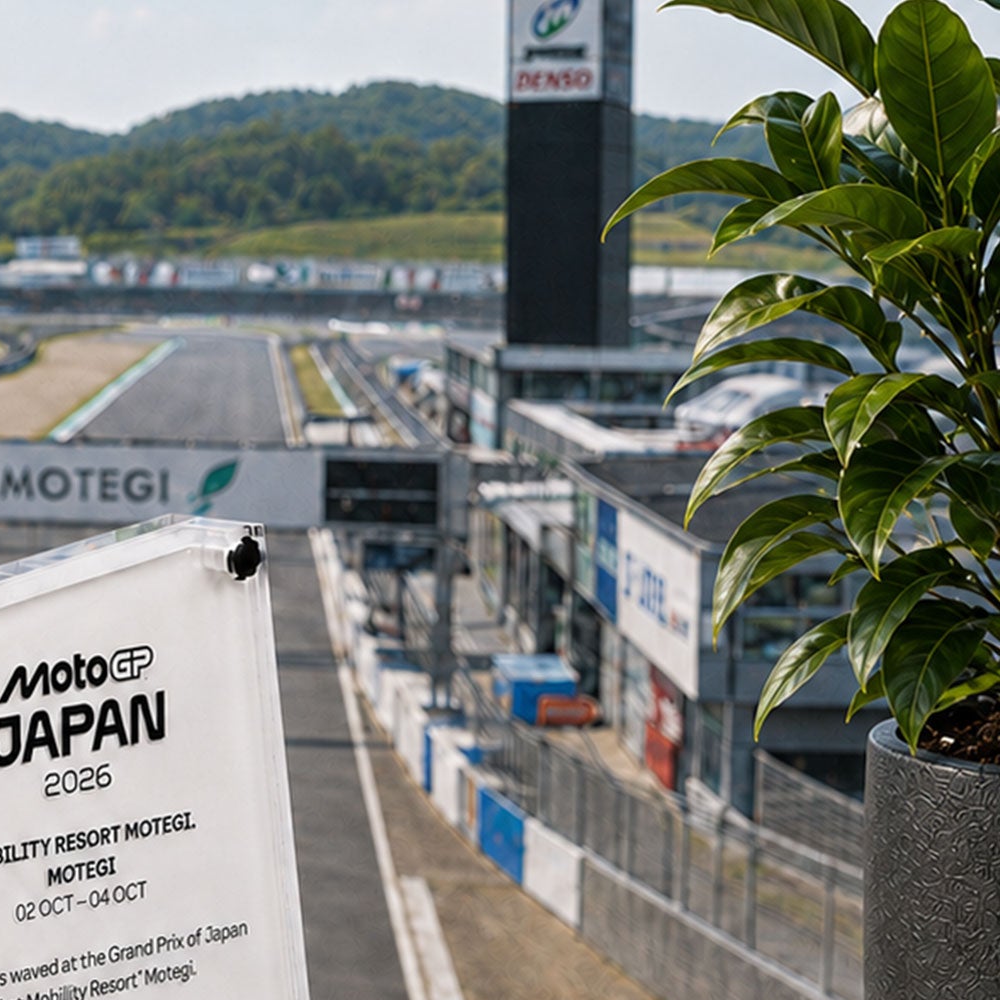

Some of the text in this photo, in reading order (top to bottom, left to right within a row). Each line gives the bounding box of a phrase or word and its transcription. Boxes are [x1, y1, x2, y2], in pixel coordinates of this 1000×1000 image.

[515, 68, 593, 91] DENSO
[0, 464, 170, 504] MOTEGI
[44, 763, 112, 797] 2026
[55, 825, 121, 854] RESORT
[47, 856, 117, 887] MOTEGI
[15, 901, 36, 922] 02
[39, 894, 75, 917] OCT
[89, 888, 110, 908] 04
[113, 880, 148, 903] OCT
[10, 956, 59, 984] waved
[61, 956, 78, 973] at
[81, 950, 106, 970] the
[108, 938, 153, 964] Grand
[156, 933, 185, 954] Prix
[187, 927, 202, 948] of
[205, 922, 248, 945] Japan
